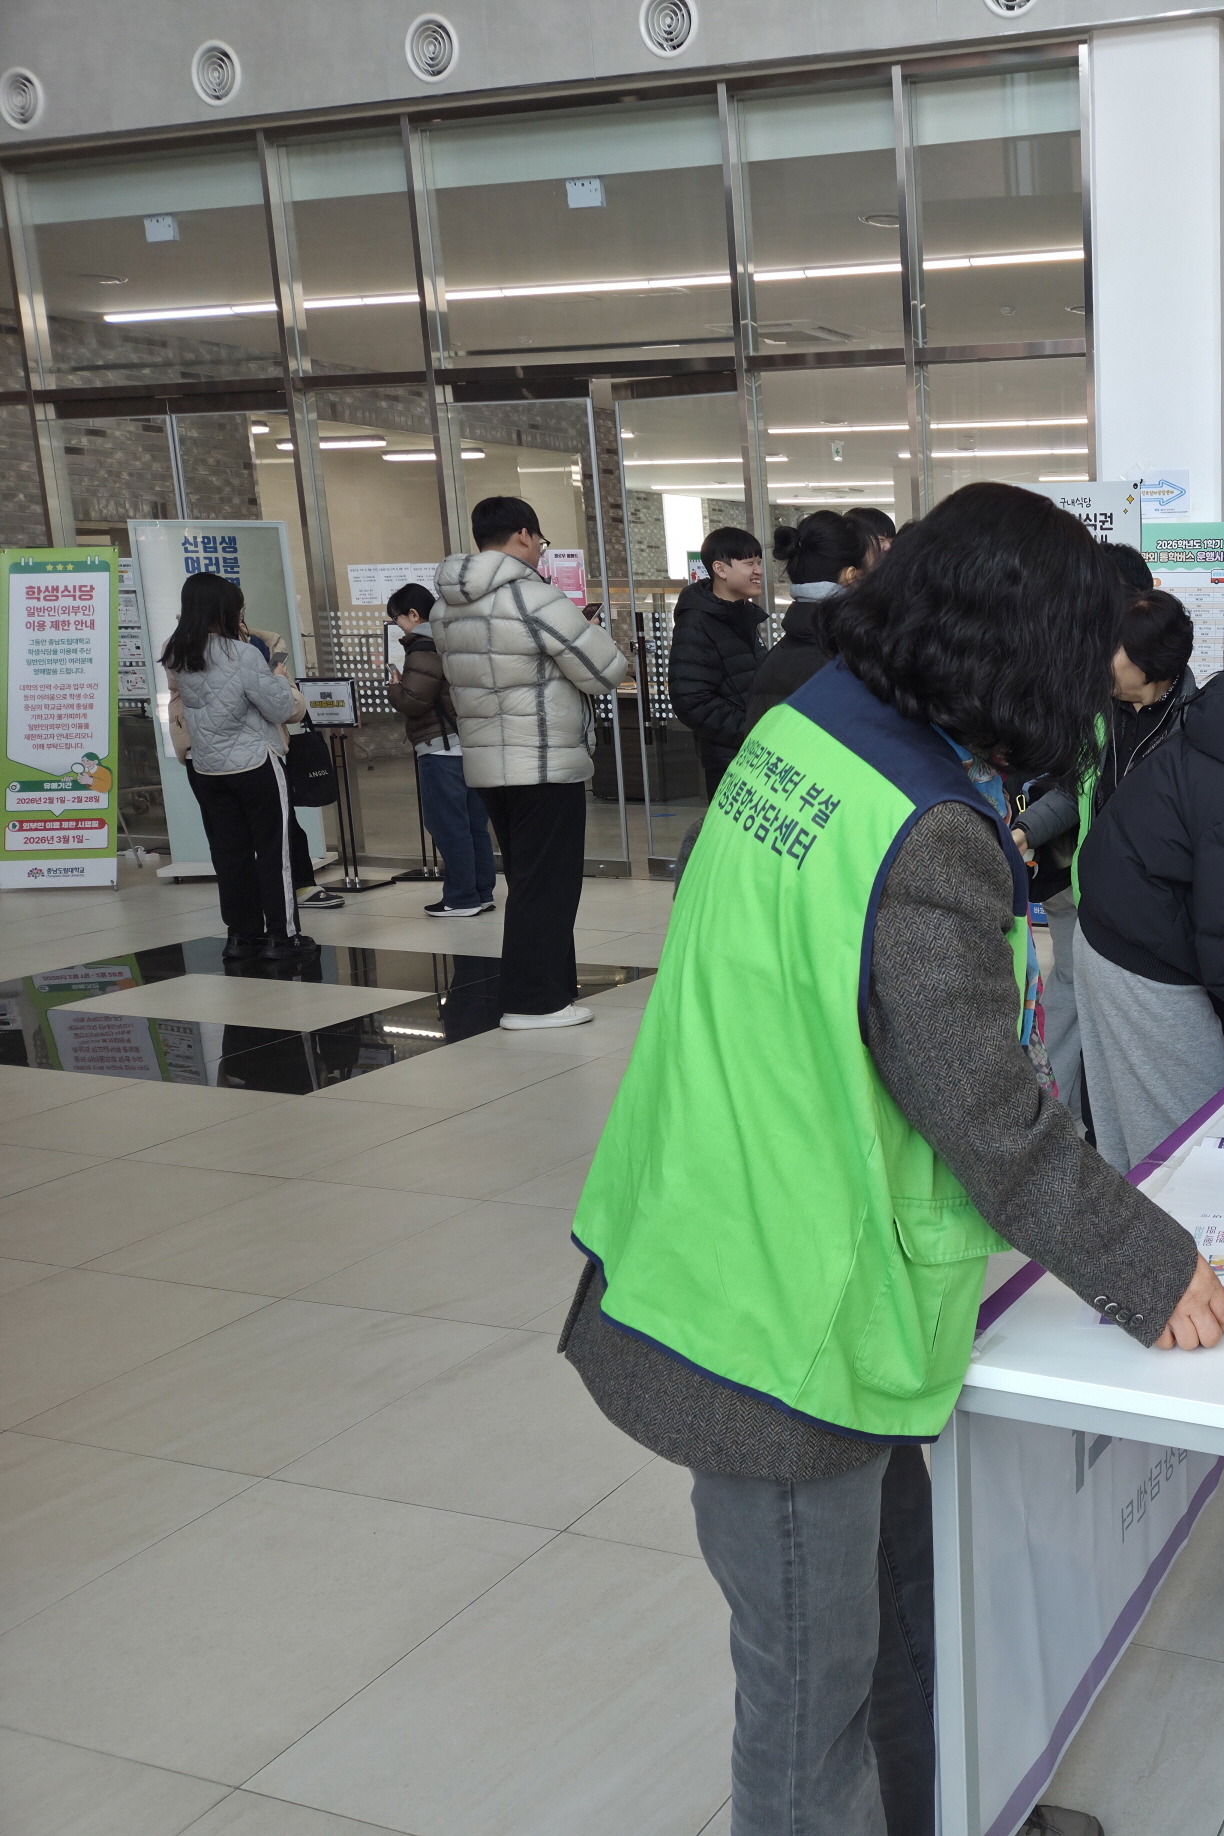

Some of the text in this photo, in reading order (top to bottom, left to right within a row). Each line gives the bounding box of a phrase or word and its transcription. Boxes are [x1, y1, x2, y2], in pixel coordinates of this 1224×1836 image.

[1060, 497, 1091, 508] 구내식당
[1078, 512, 1113, 531] 식권
[181, 535, 239, 554] 신입생
[1156, 539, 1224, 550] 2026학년도 1학기
[1160, 552, 1195, 562] 통학버스
[184, 556, 241, 575] 여러분
[25, 585, 95, 602] 학생식당
[25, 605, 95, 618] 일반인(외부인)
[25, 619, 95, 632] 이용 제한 안내
[48, 638, 91, 646] 충남도립대학교
[26, 658, 67, 666] 일반인(외부인)
[56, 796, 65, 804] 1일
[84, 795, 99, 803] 28일
[799, 782, 841, 829] 부설
[23, 836, 54, 844] 2026년
[56, 835, 69, 844] 3월
[72, 834, 84, 843] 1일
